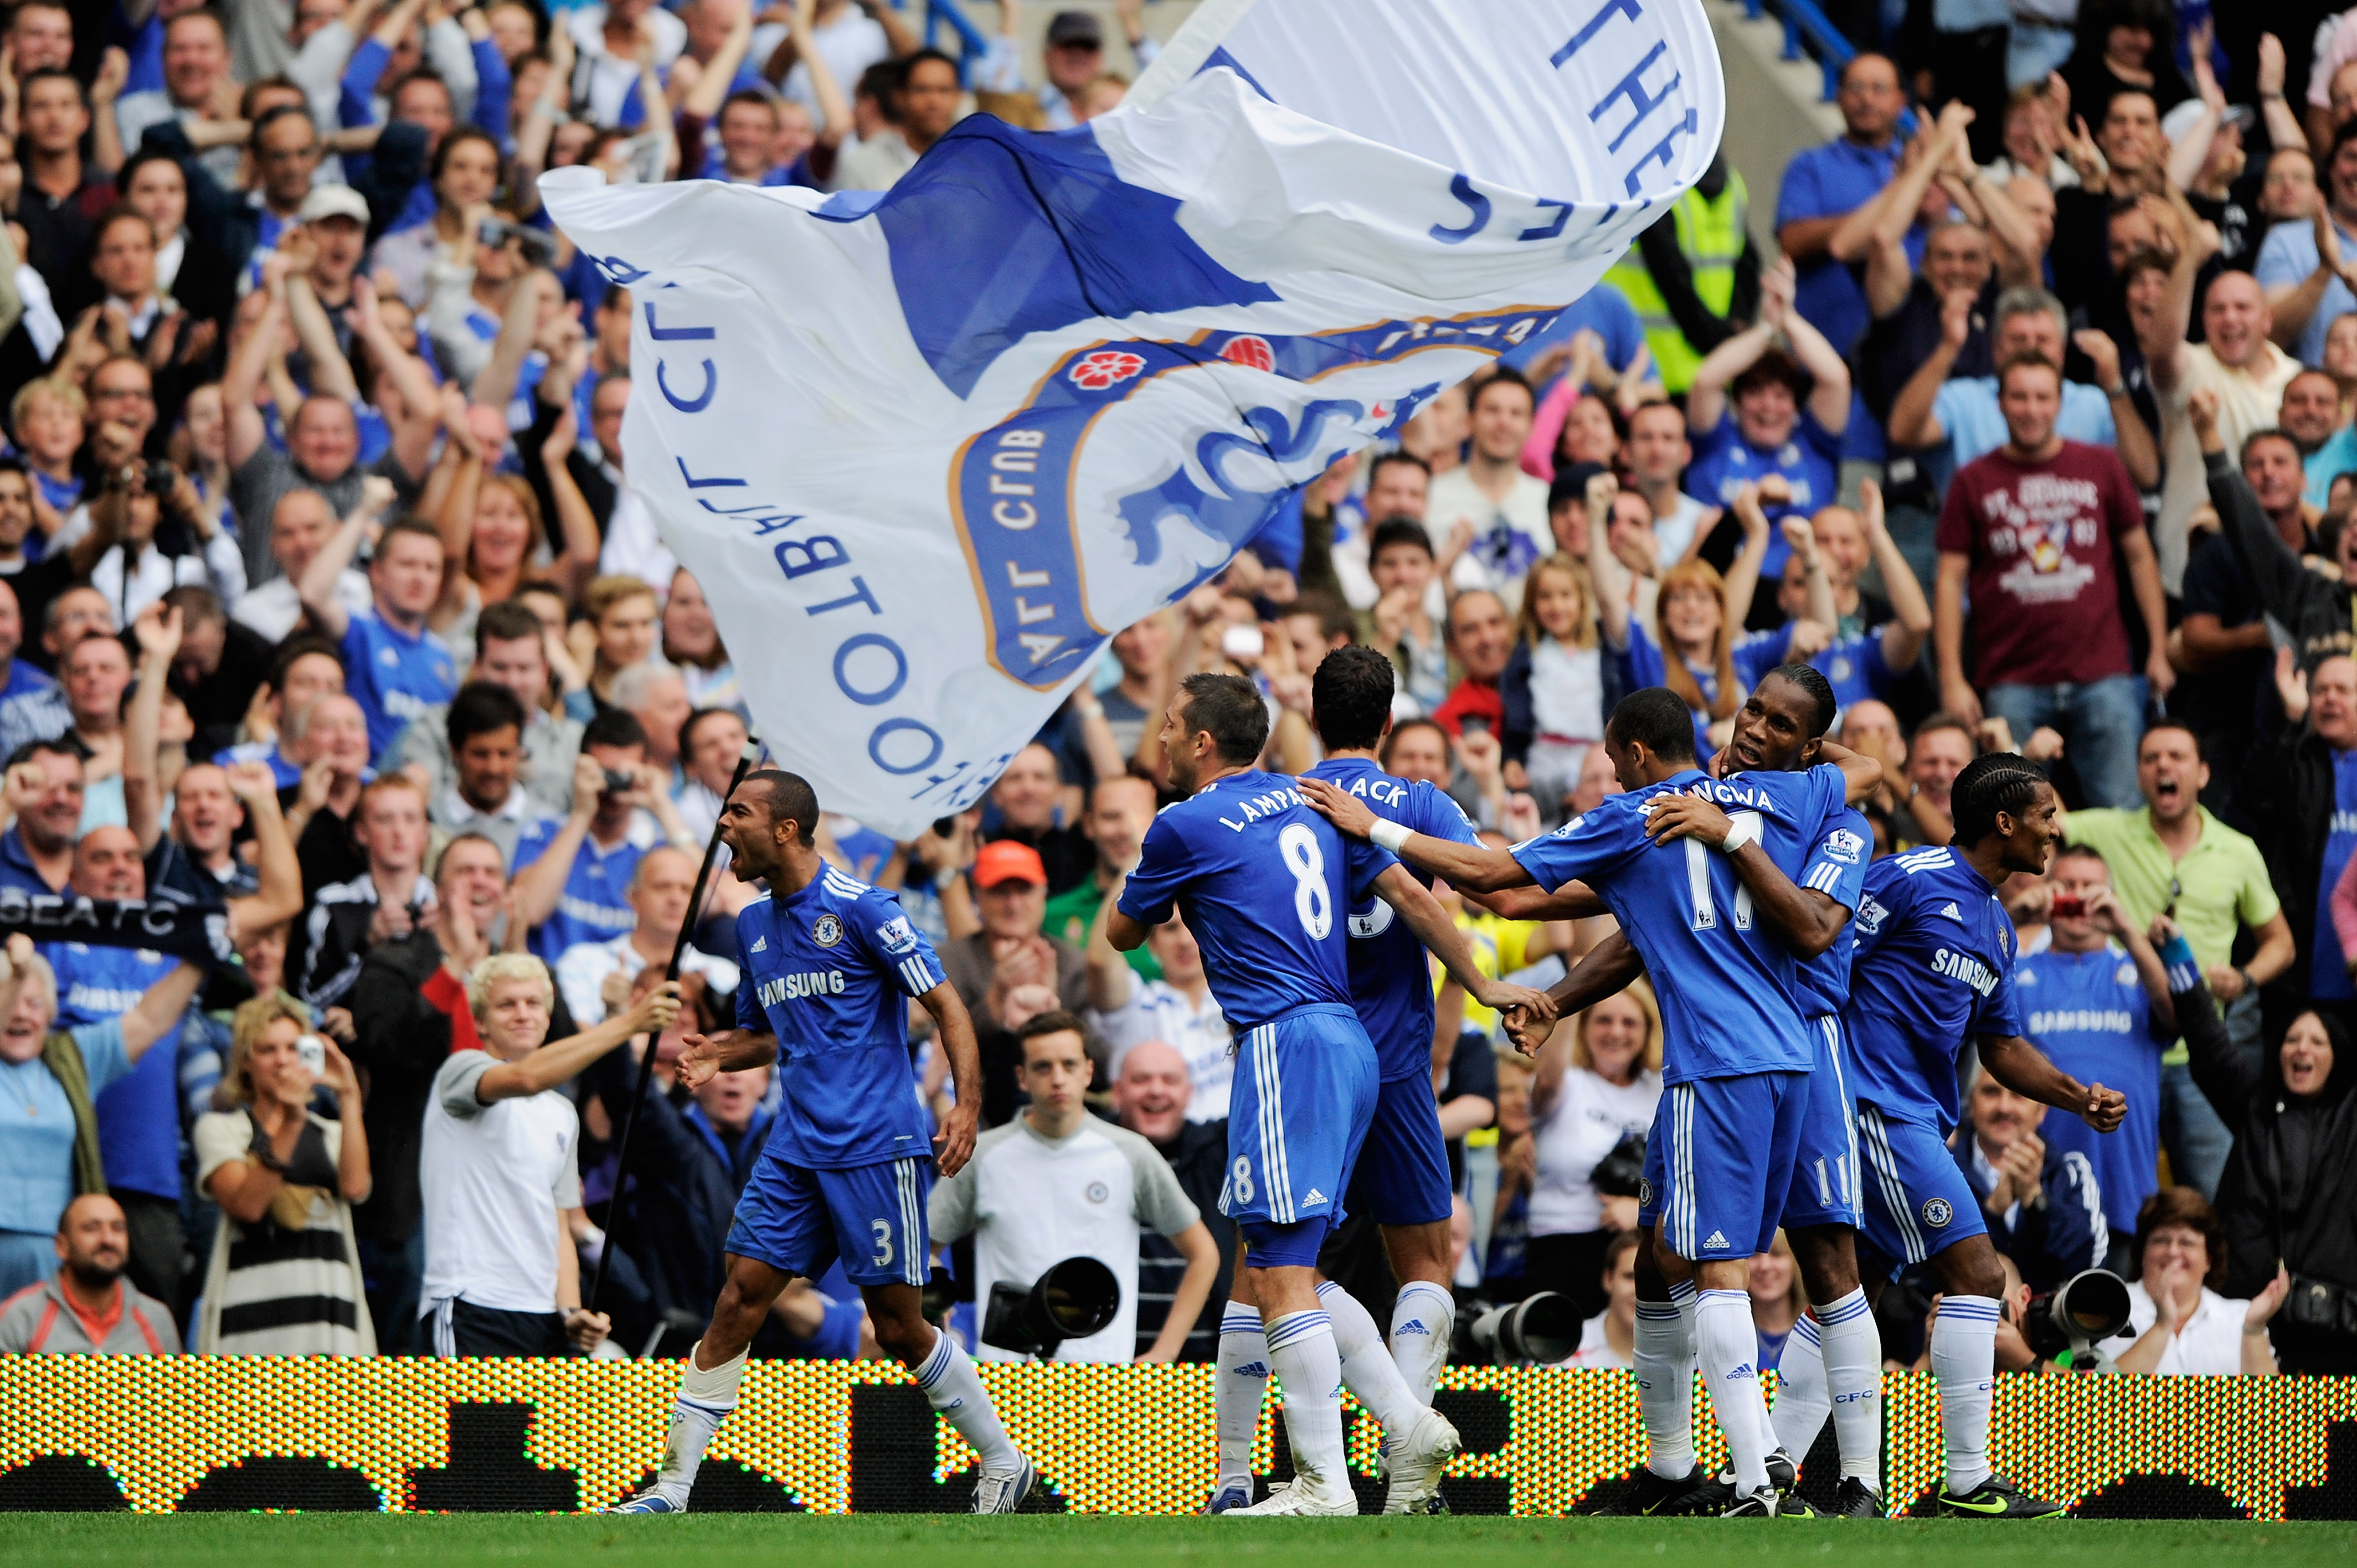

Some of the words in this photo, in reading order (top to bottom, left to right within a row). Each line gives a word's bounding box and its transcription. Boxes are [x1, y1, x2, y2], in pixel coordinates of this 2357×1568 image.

[1279, 822, 1332, 941] 8
[757, 970, 845, 1010] SAMSUNG
[2029, 1009, 2132, 1035] SAMSUNG
[1233, 1154, 1255, 1205] 8
[1814, 1153, 1851, 1207] 11
[871, 1218, 894, 1267] 3
[1396, 1327, 1430, 1336] adidas
[1835, 1390, 1874, 1404] CFC
